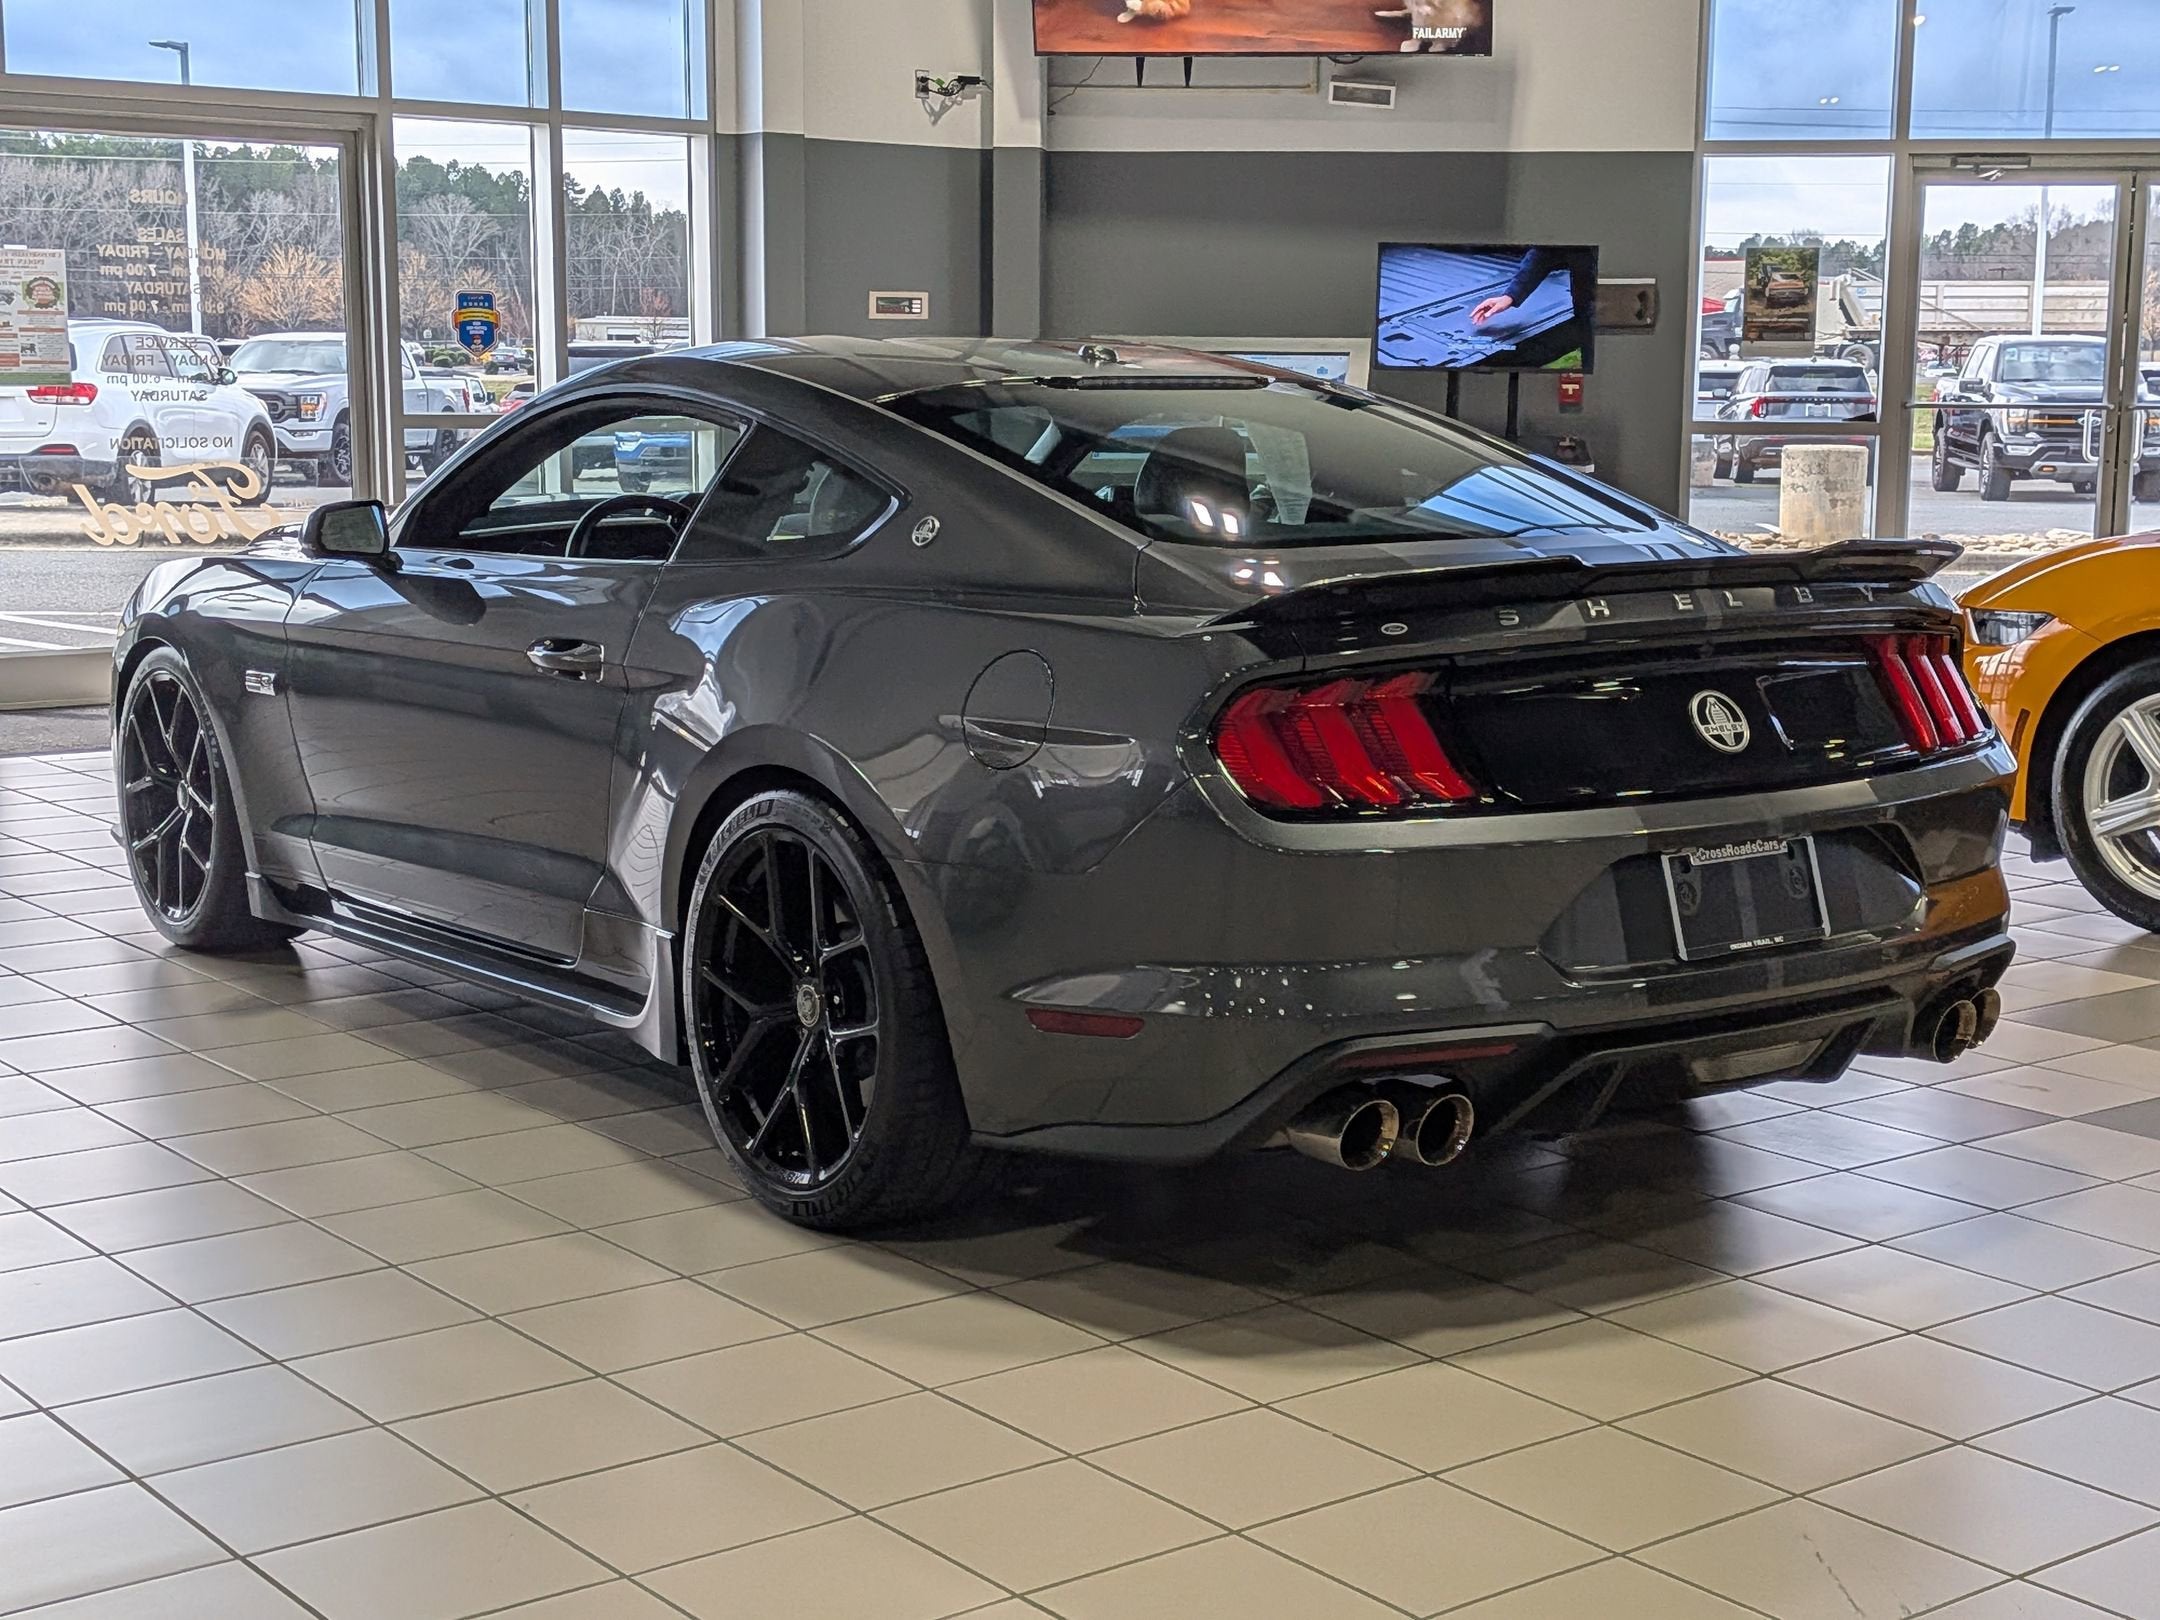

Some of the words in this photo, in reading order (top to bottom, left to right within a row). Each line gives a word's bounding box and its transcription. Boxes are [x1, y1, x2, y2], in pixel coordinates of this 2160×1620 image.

[1413, 27, 1463, 38] FAILARMY
[1499, 584, 1875, 626] SHELBY
[1702, 722, 1744, 735] SHELBY
